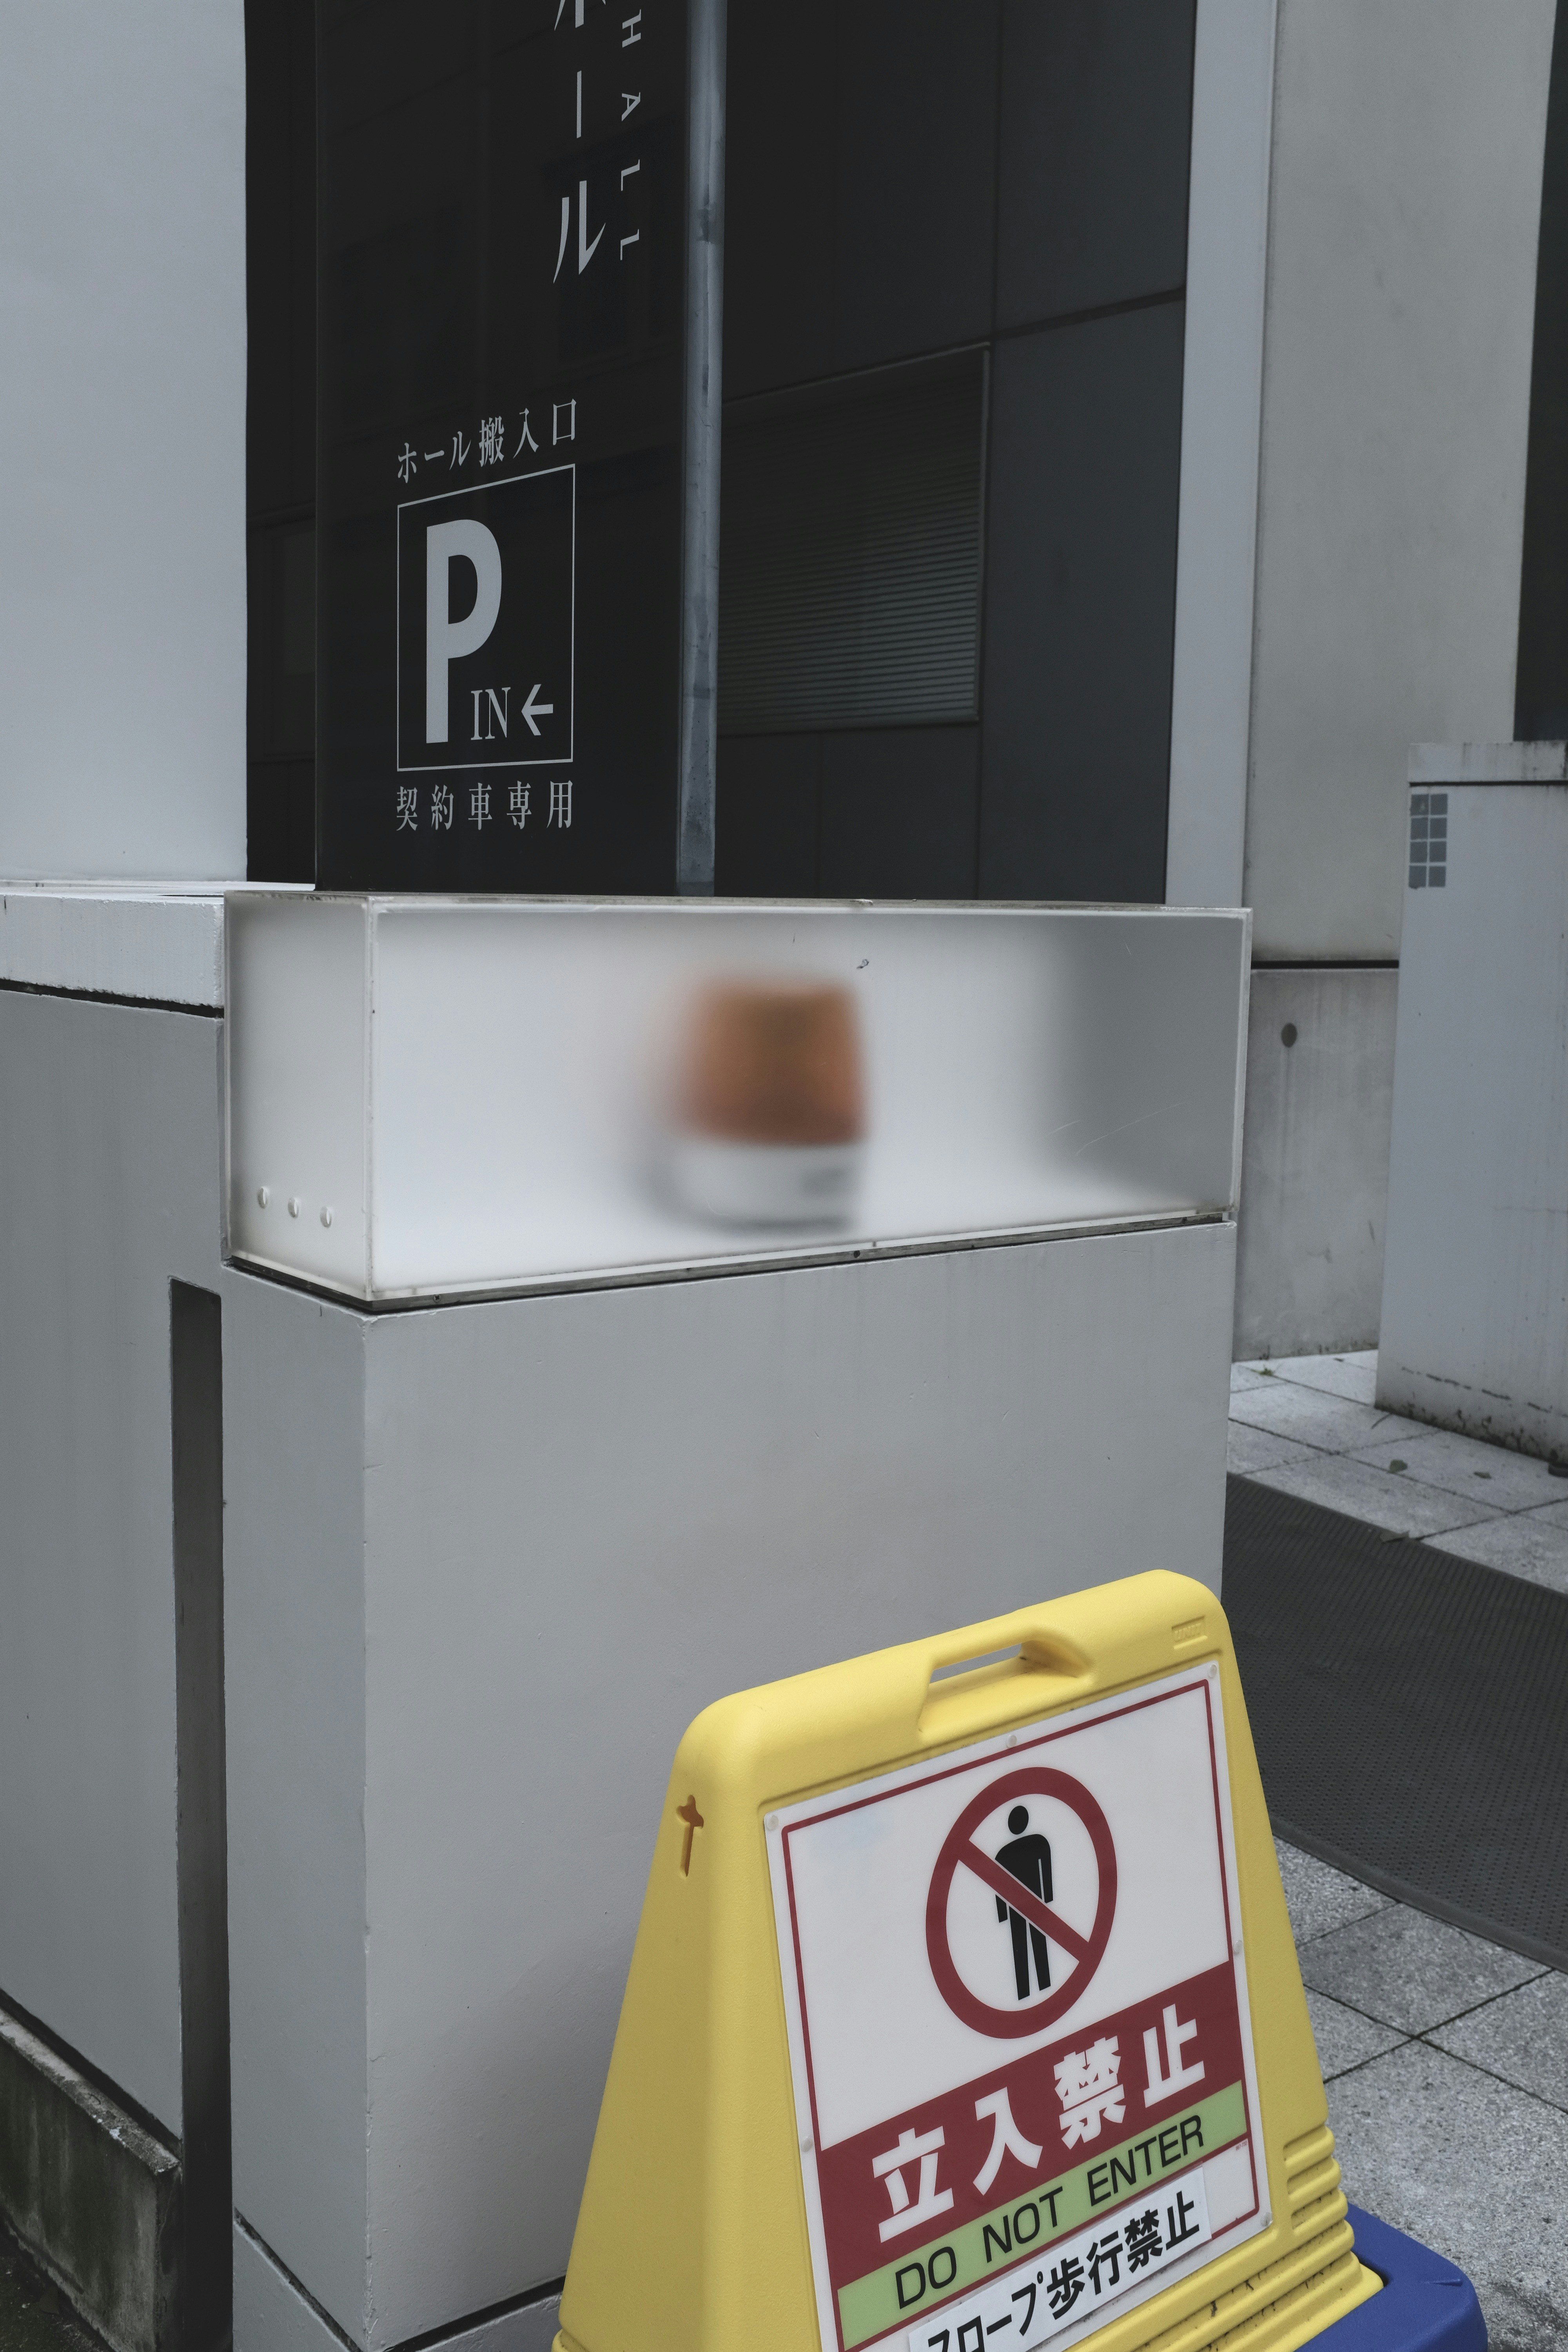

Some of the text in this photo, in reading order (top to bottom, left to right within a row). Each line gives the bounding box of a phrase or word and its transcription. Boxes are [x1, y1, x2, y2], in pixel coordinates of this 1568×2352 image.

[621, 9, 641, 260] HALL
[397, 399, 577, 483] ホール搬入口
[426, 519, 502, 743] P
[471, 687, 511, 740] IN
[396, 780, 573, 831] 契約車専用
[872, 2004, 1205, 2243] 立入禁止
[895, 2115, 1203, 2309] DO NOT ENTER
